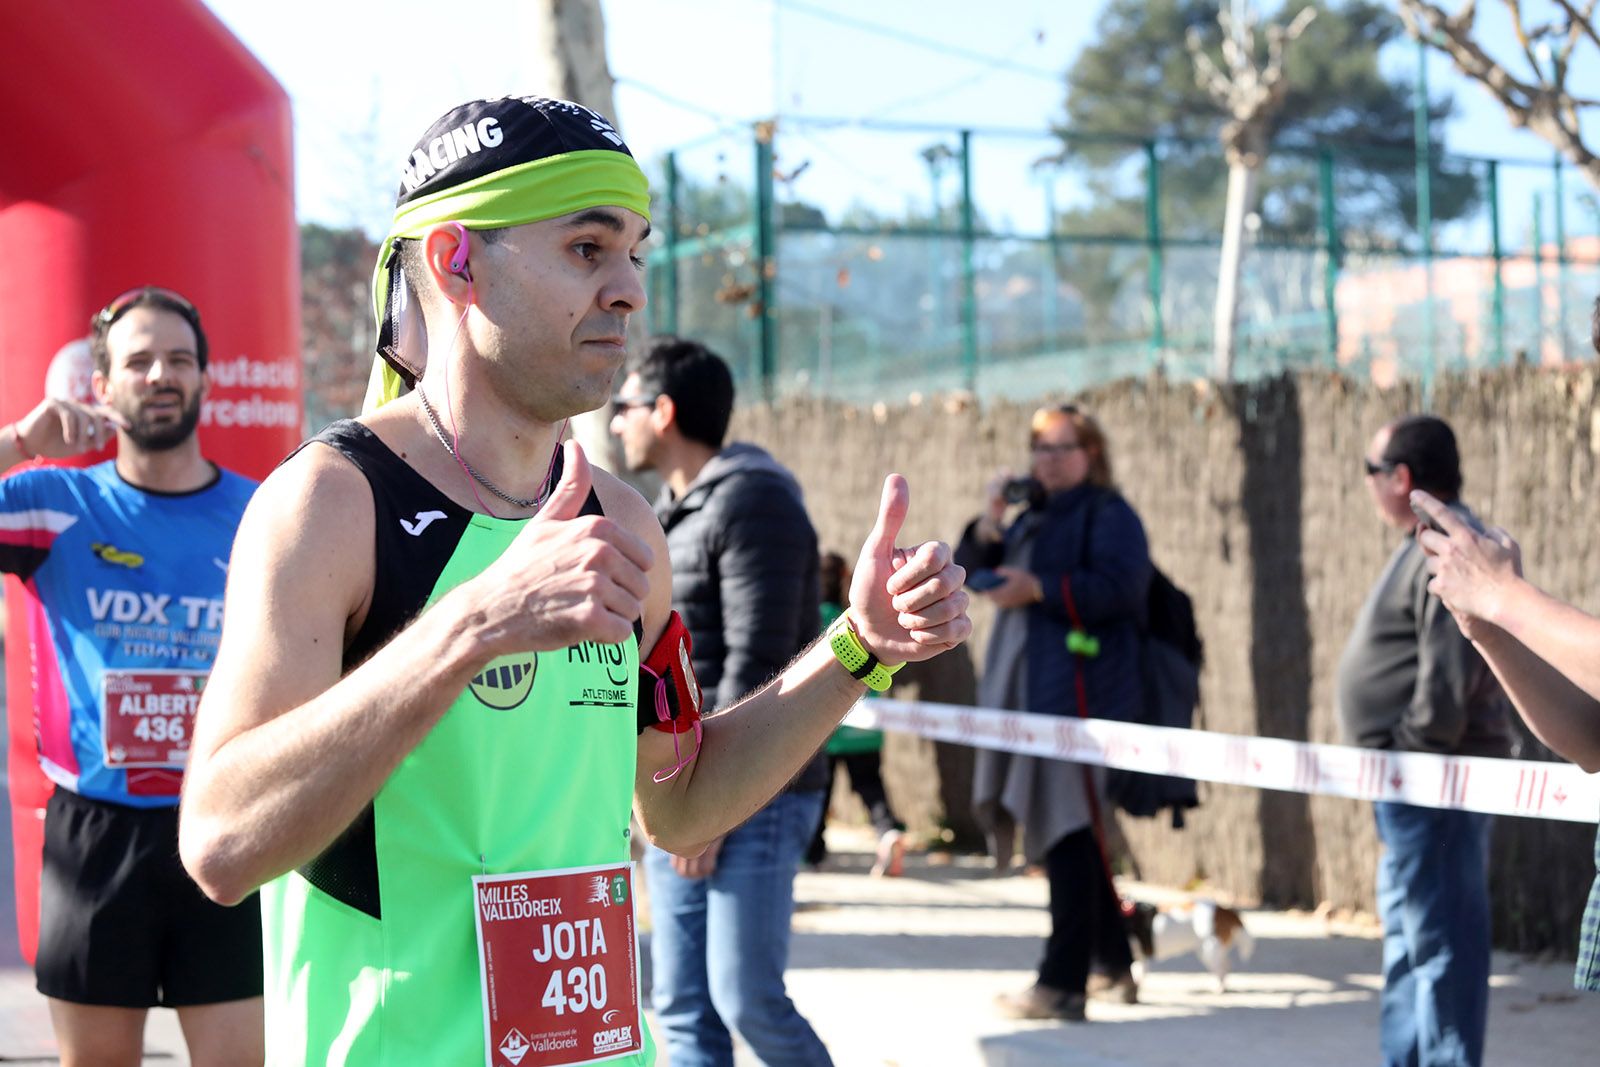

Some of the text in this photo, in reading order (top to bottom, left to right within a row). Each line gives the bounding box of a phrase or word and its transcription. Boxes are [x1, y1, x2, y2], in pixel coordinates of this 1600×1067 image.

[402, 117, 503, 193] RACING
[86, 587, 171, 625] VDX
[583, 688, 626, 700] ATLETISME
[133, 716, 185, 742] 436
[480, 884, 528, 904] MILLES
[616, 883, 621, 896] 1
[482, 898, 562, 921] VALLDOREIX
[533, 917, 607, 963] JOTA
[542, 963, 607, 1015] 430
[531, 1036, 577, 1053] Valldoreix
[594, 1025, 632, 1047] COMPLEX
